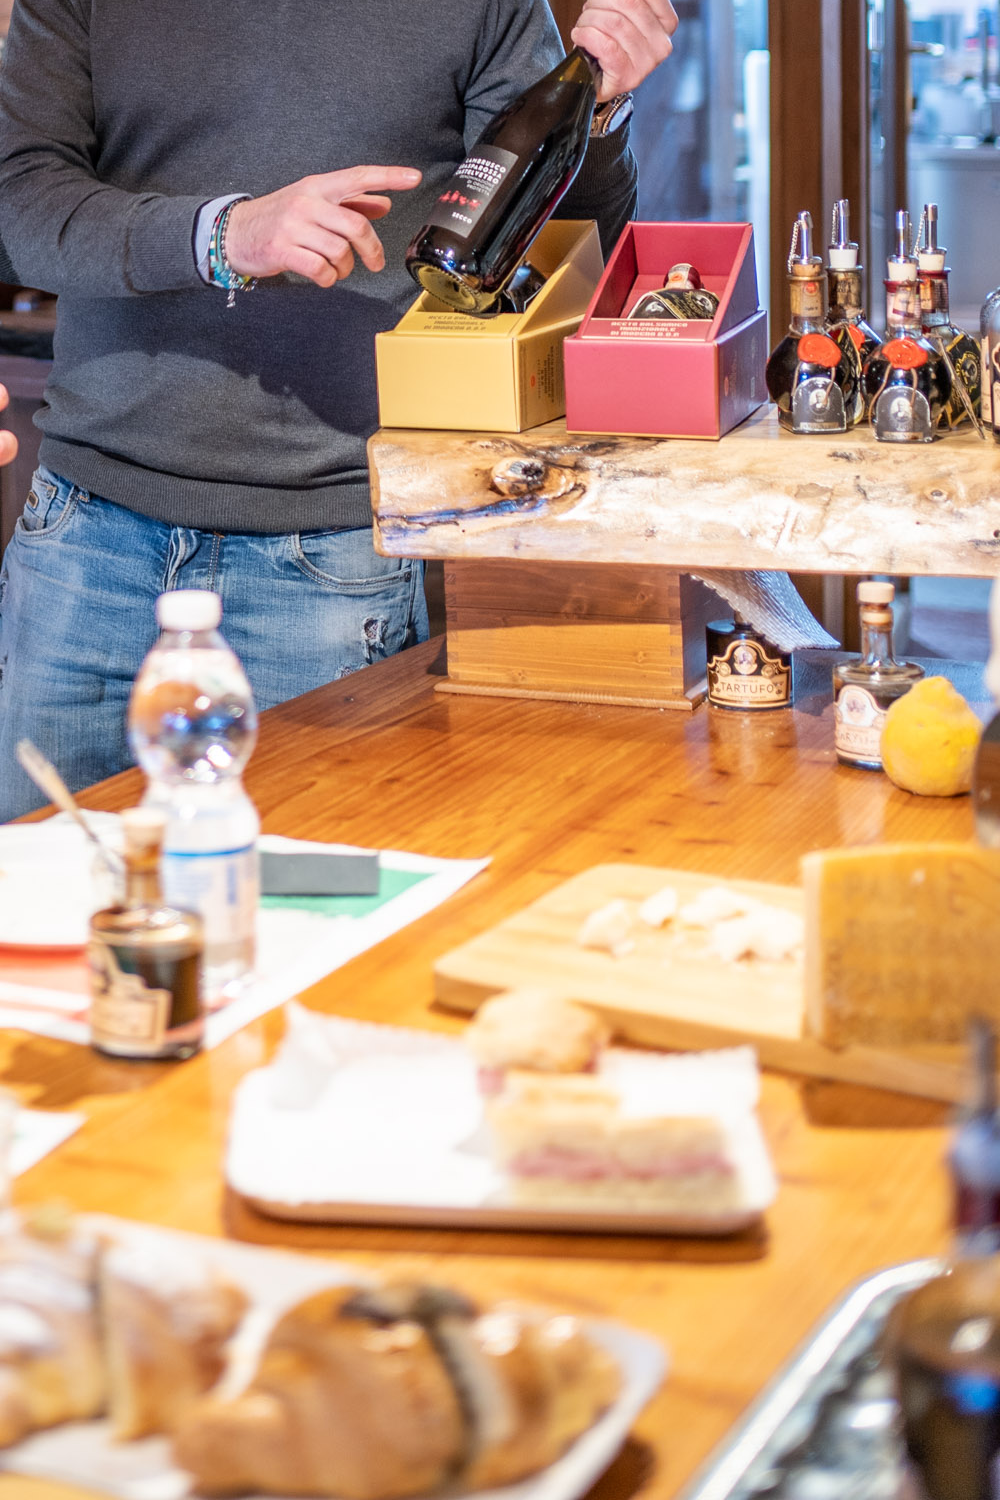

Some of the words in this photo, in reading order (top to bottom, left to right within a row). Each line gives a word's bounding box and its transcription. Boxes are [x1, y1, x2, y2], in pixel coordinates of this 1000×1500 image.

[465, 158, 506, 173] LAMBRUSCO
[452, 211, 473, 224] SECCO
[720, 681, 774, 694] TARTUFO
